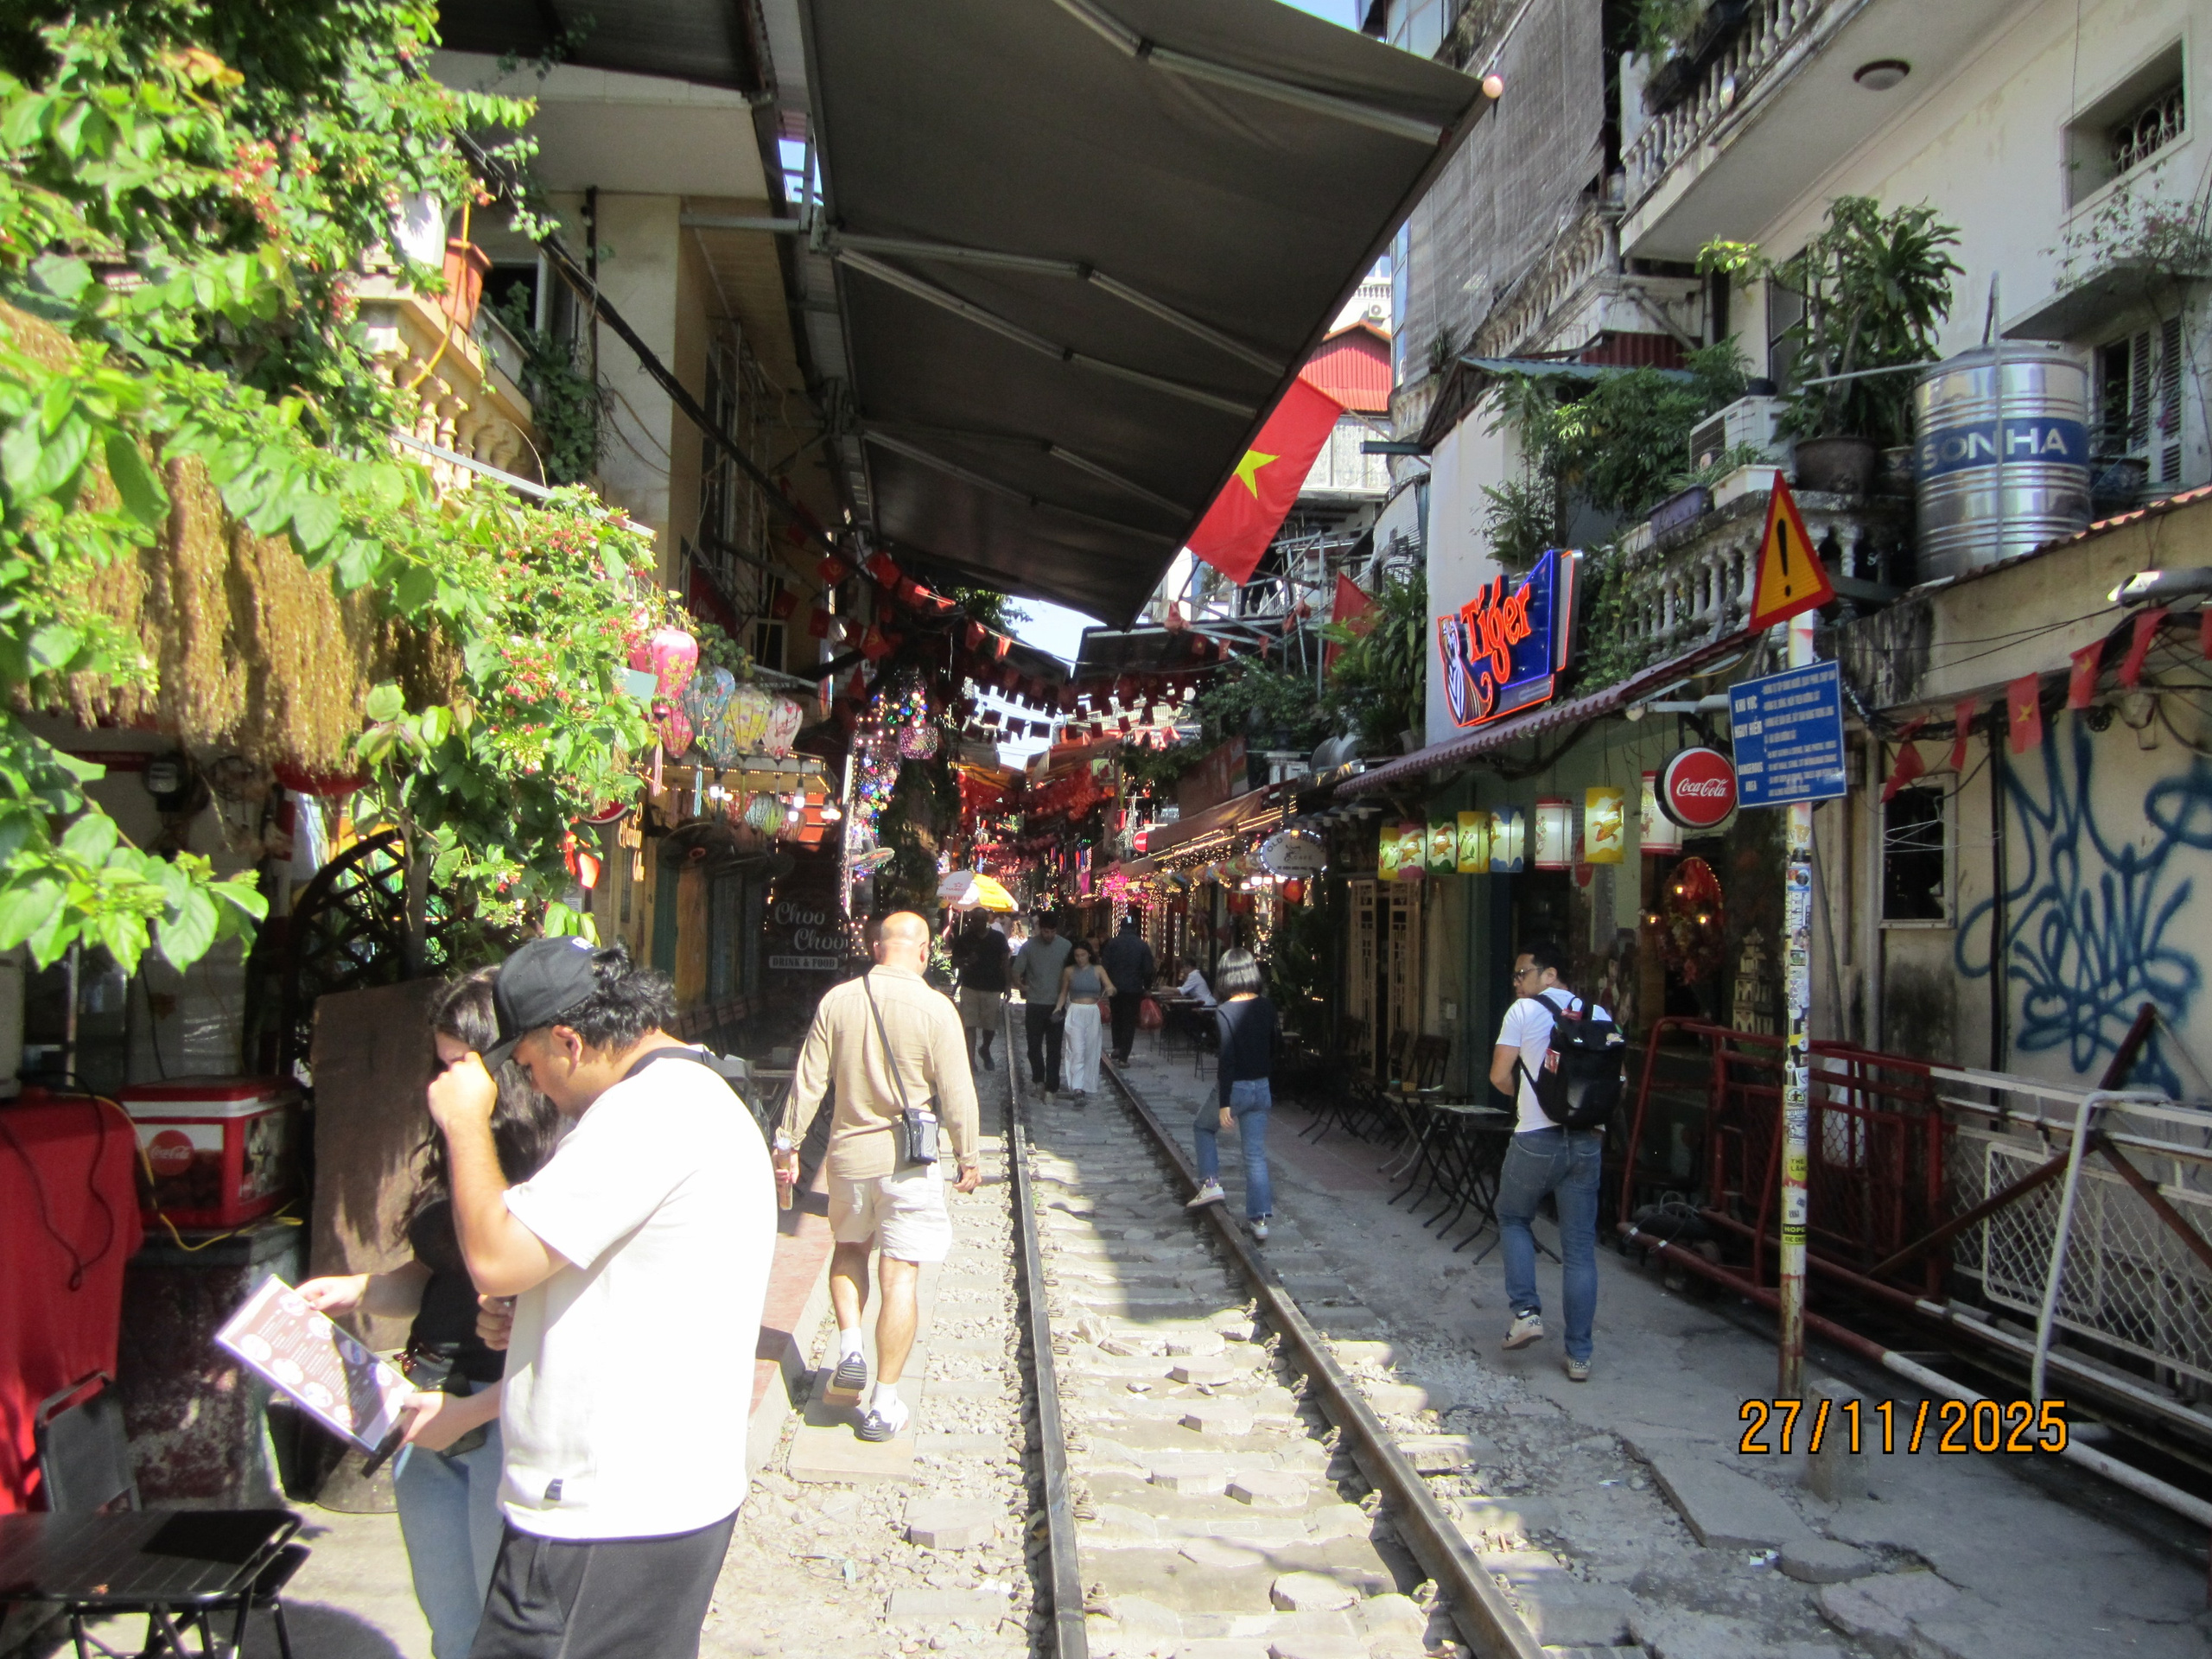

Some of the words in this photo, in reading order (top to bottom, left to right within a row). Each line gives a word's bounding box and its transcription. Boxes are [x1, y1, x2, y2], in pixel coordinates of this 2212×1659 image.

[1460, 575, 1532, 684] Tiger
[1676, 778, 1729, 797] Coca-Cola
[1267, 837, 1283, 852] OLD
[775, 901, 825, 925] Choo
[794, 928, 845, 950] Choo
[772, 957, 799, 967] DRINK
[803, 958, 809, 967] &
[812, 958, 836, 967] FOOD
[149, 1145, 191, 1160] Coca-Cola
